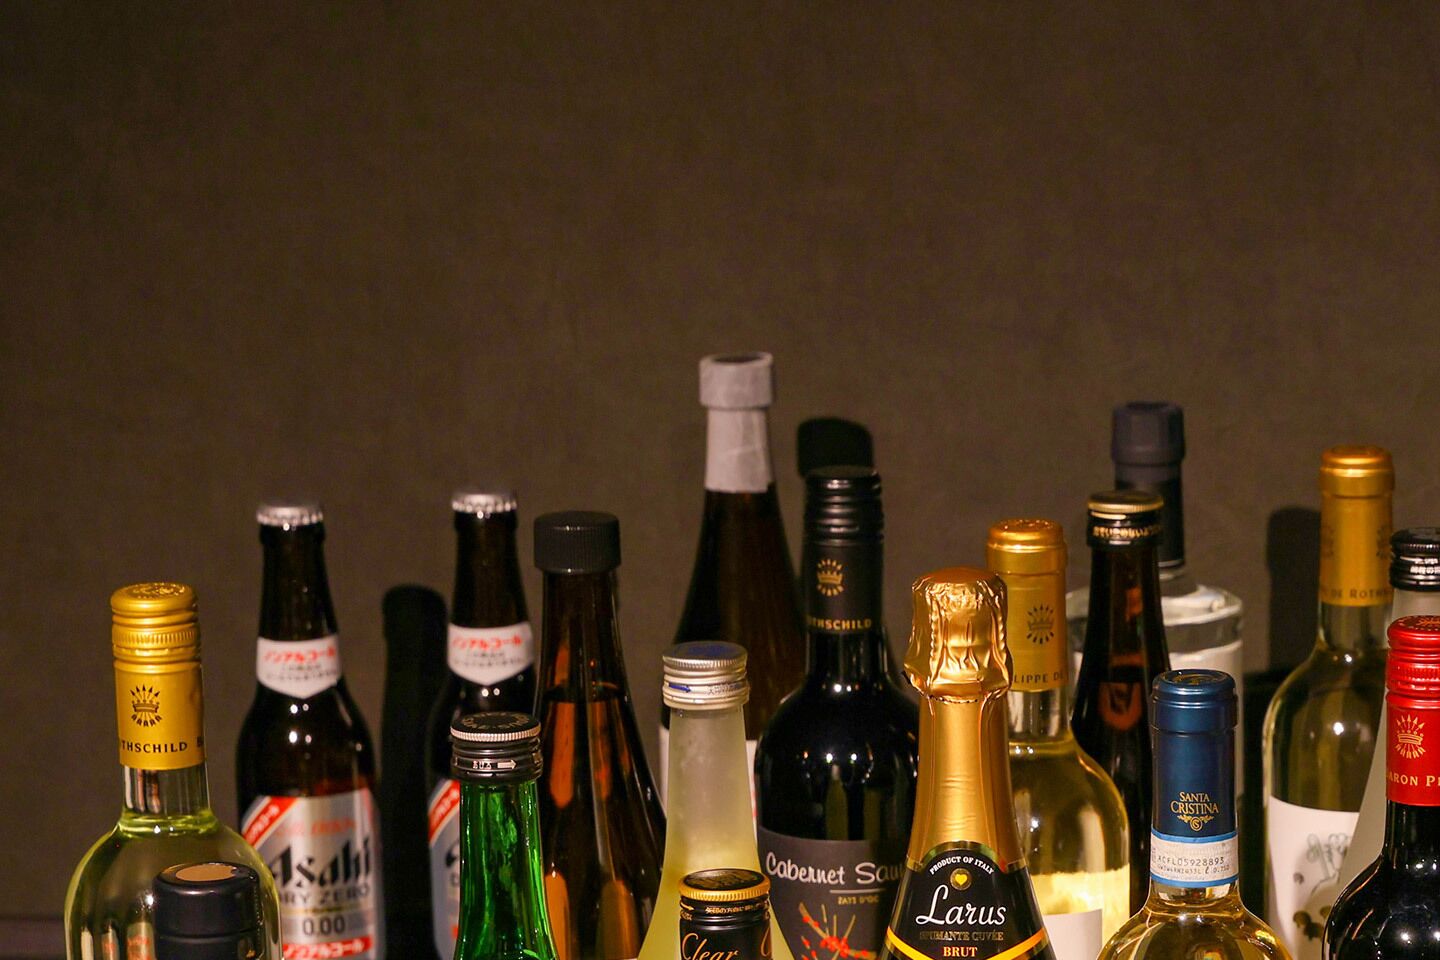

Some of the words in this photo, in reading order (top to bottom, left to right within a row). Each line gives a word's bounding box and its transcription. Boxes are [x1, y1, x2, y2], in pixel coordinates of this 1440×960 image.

[121, 739, 188, 753] THSCHILD
[1179, 791, 1210, 802] SANTA
[1170, 800, 1220, 815] CRISTINA
[765, 851, 845, 886] Cabernet
[929, 856, 962, 875] PRODUCT
[962, 855, 974, 864] OF
[974, 860, 995, 875] ITALY
[915, 884, 1007, 926] Larus
[943, 946, 978, 957] BRUT
